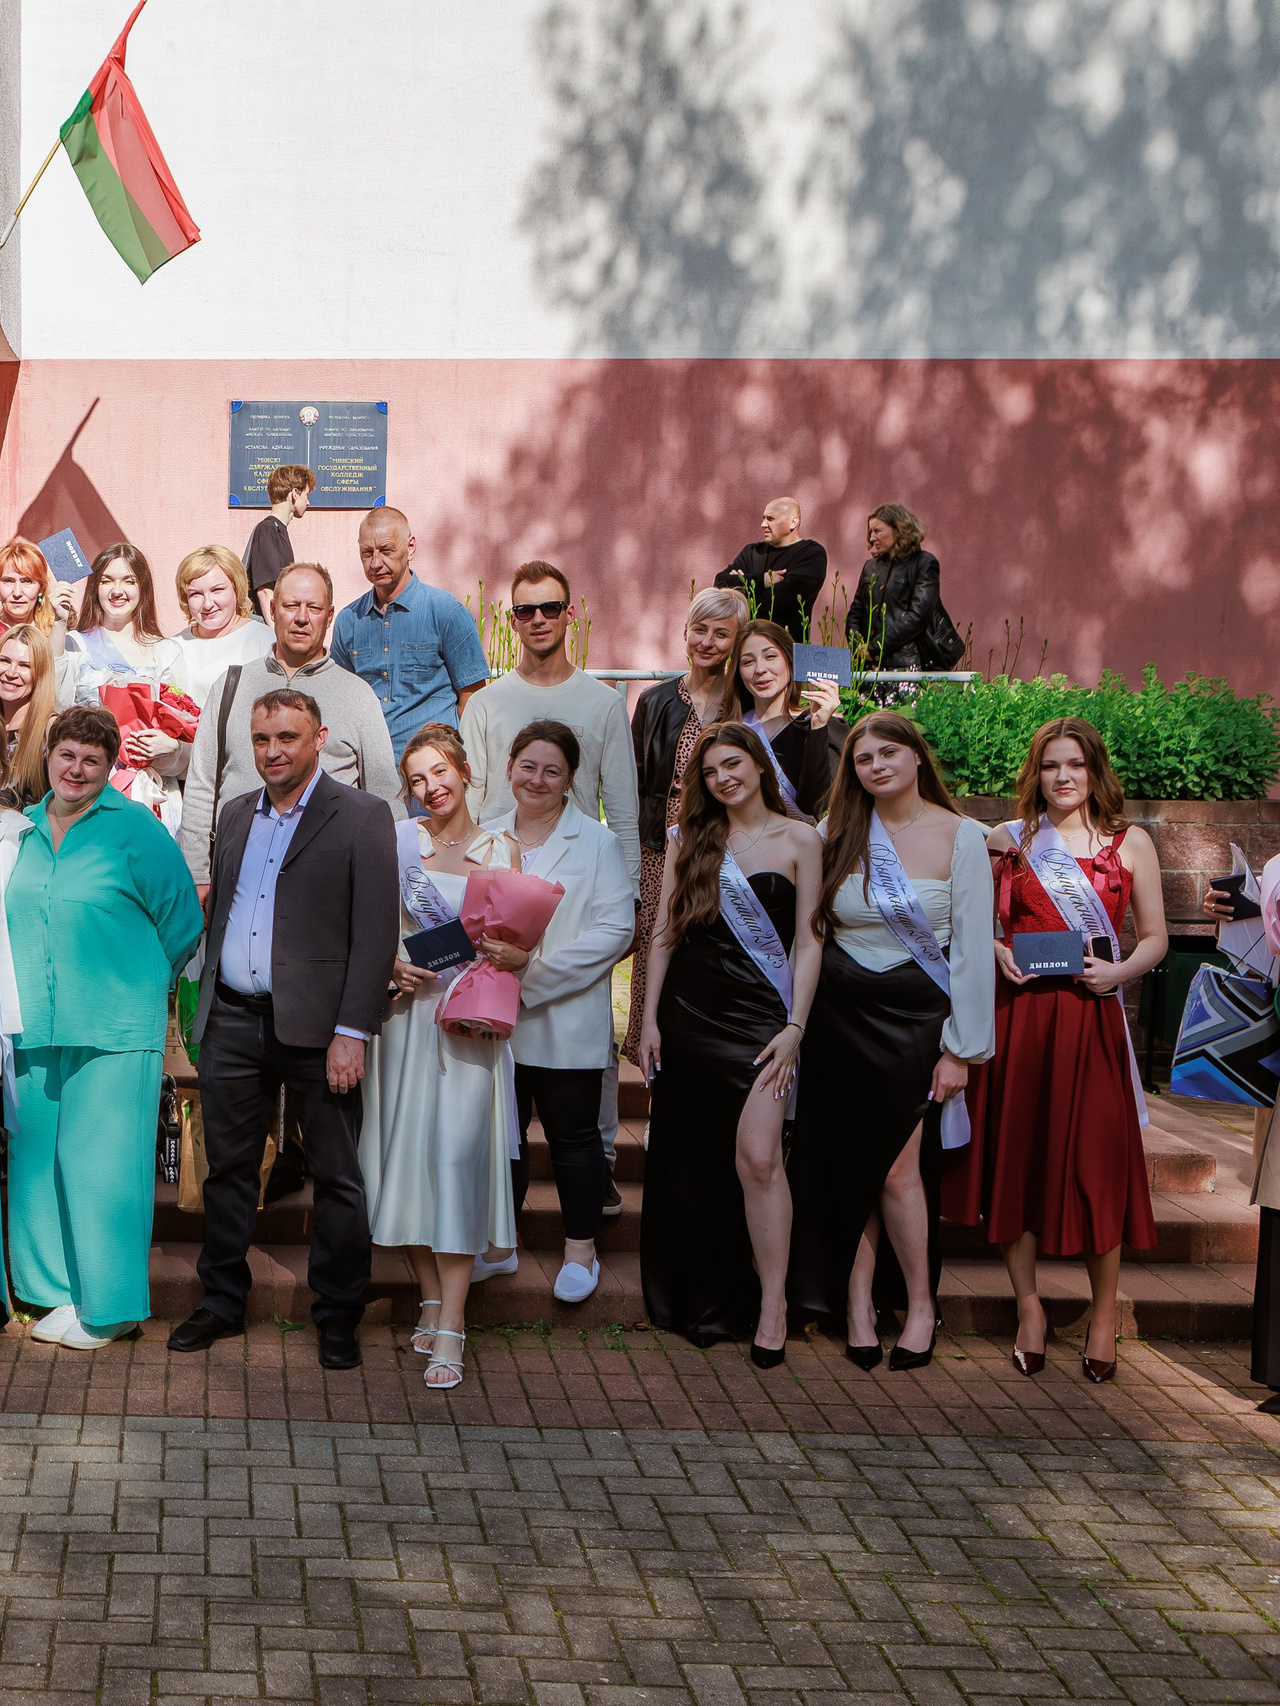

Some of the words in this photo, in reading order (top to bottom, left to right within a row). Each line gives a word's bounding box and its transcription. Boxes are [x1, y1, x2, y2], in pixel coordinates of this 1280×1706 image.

[65, 540, 84, 569] ДЫПЛОМ
[806, 671, 839, 681] ДЫПЛОМ
[868, 843, 914, 930] Выпускница
[1039, 848, 1102, 937] Выпускница
[427, 951, 460, 969] ДЫПЛОМ
[752, 929, 787, 969] 2025
[1029, 961, 1069, 969] ДЫПЛОМ
